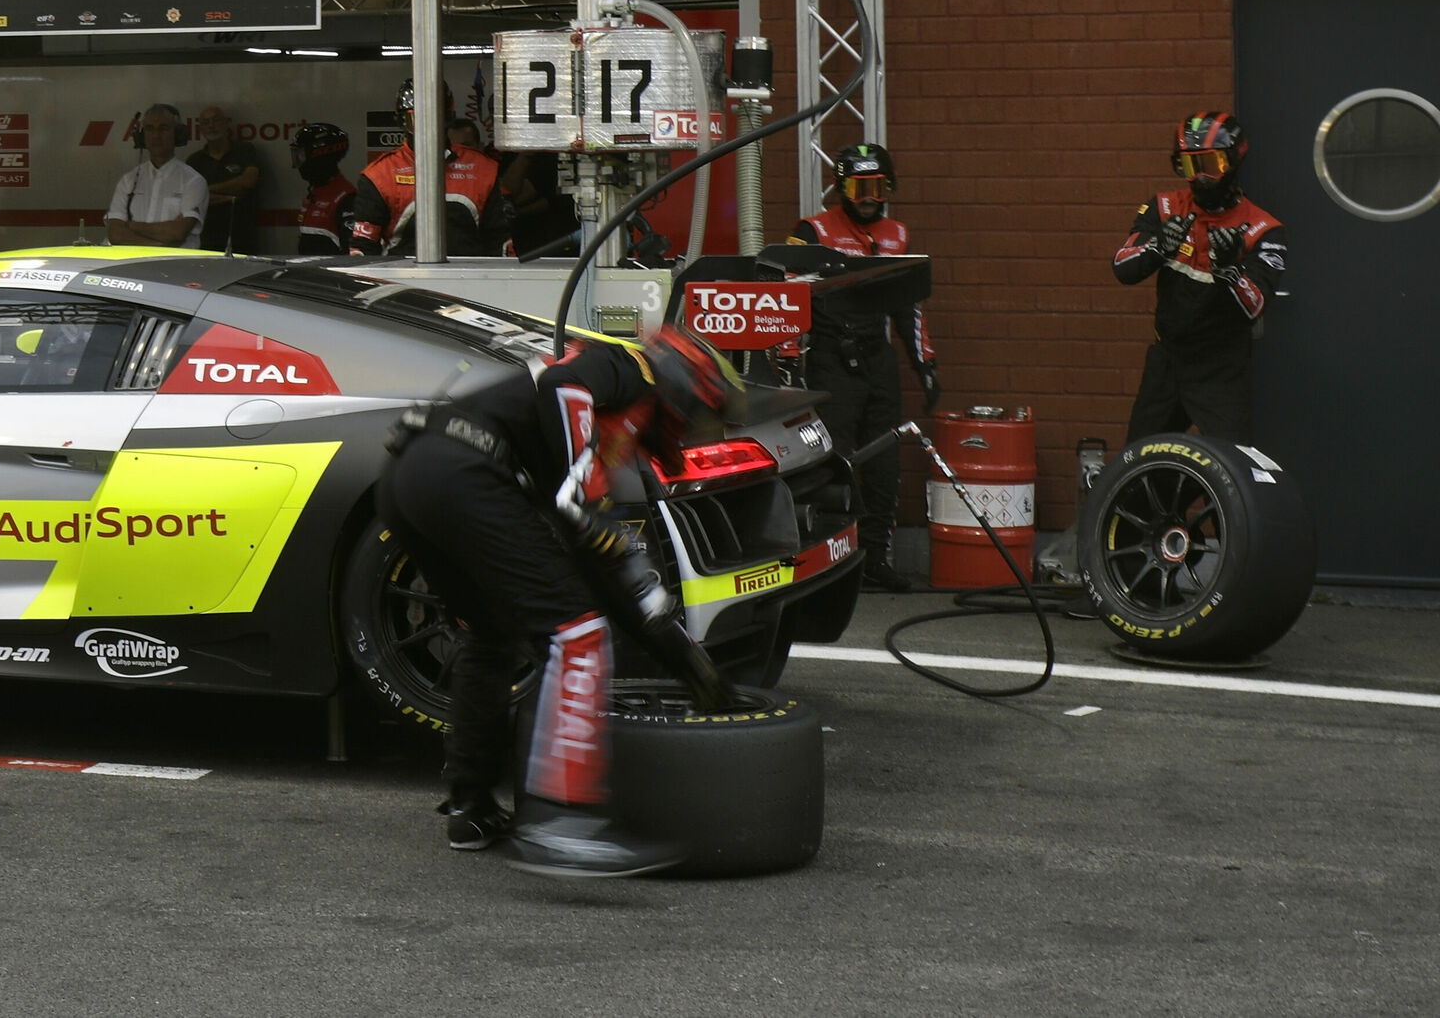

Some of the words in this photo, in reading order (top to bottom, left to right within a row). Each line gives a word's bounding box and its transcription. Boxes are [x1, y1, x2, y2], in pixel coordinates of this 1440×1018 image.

[205, 11, 232, 20] SRO
[528, 61, 556, 124] 2
[600, 59, 652, 124] 17
[14, 270, 71, 282] FÄSSLER
[101, 277, 144, 293] SERRA
[642, 281, 662, 313] 3
[692, 288, 800, 312] TOTAL
[754, 315, 786, 326] Belgian
[781, 325, 801, 333] Club
[187, 357, 309, 385] TOTAL
[1140, 442, 1212, 467] PIRELLI
[826, 535, 852, 563] TOTAL
[734, 563, 781, 596] PIRELLI
[1109, 612, 1165, 640] ZERO
[1168, 624, 1182, 639] P
[84, 638, 180, 663] GrafiWrap
